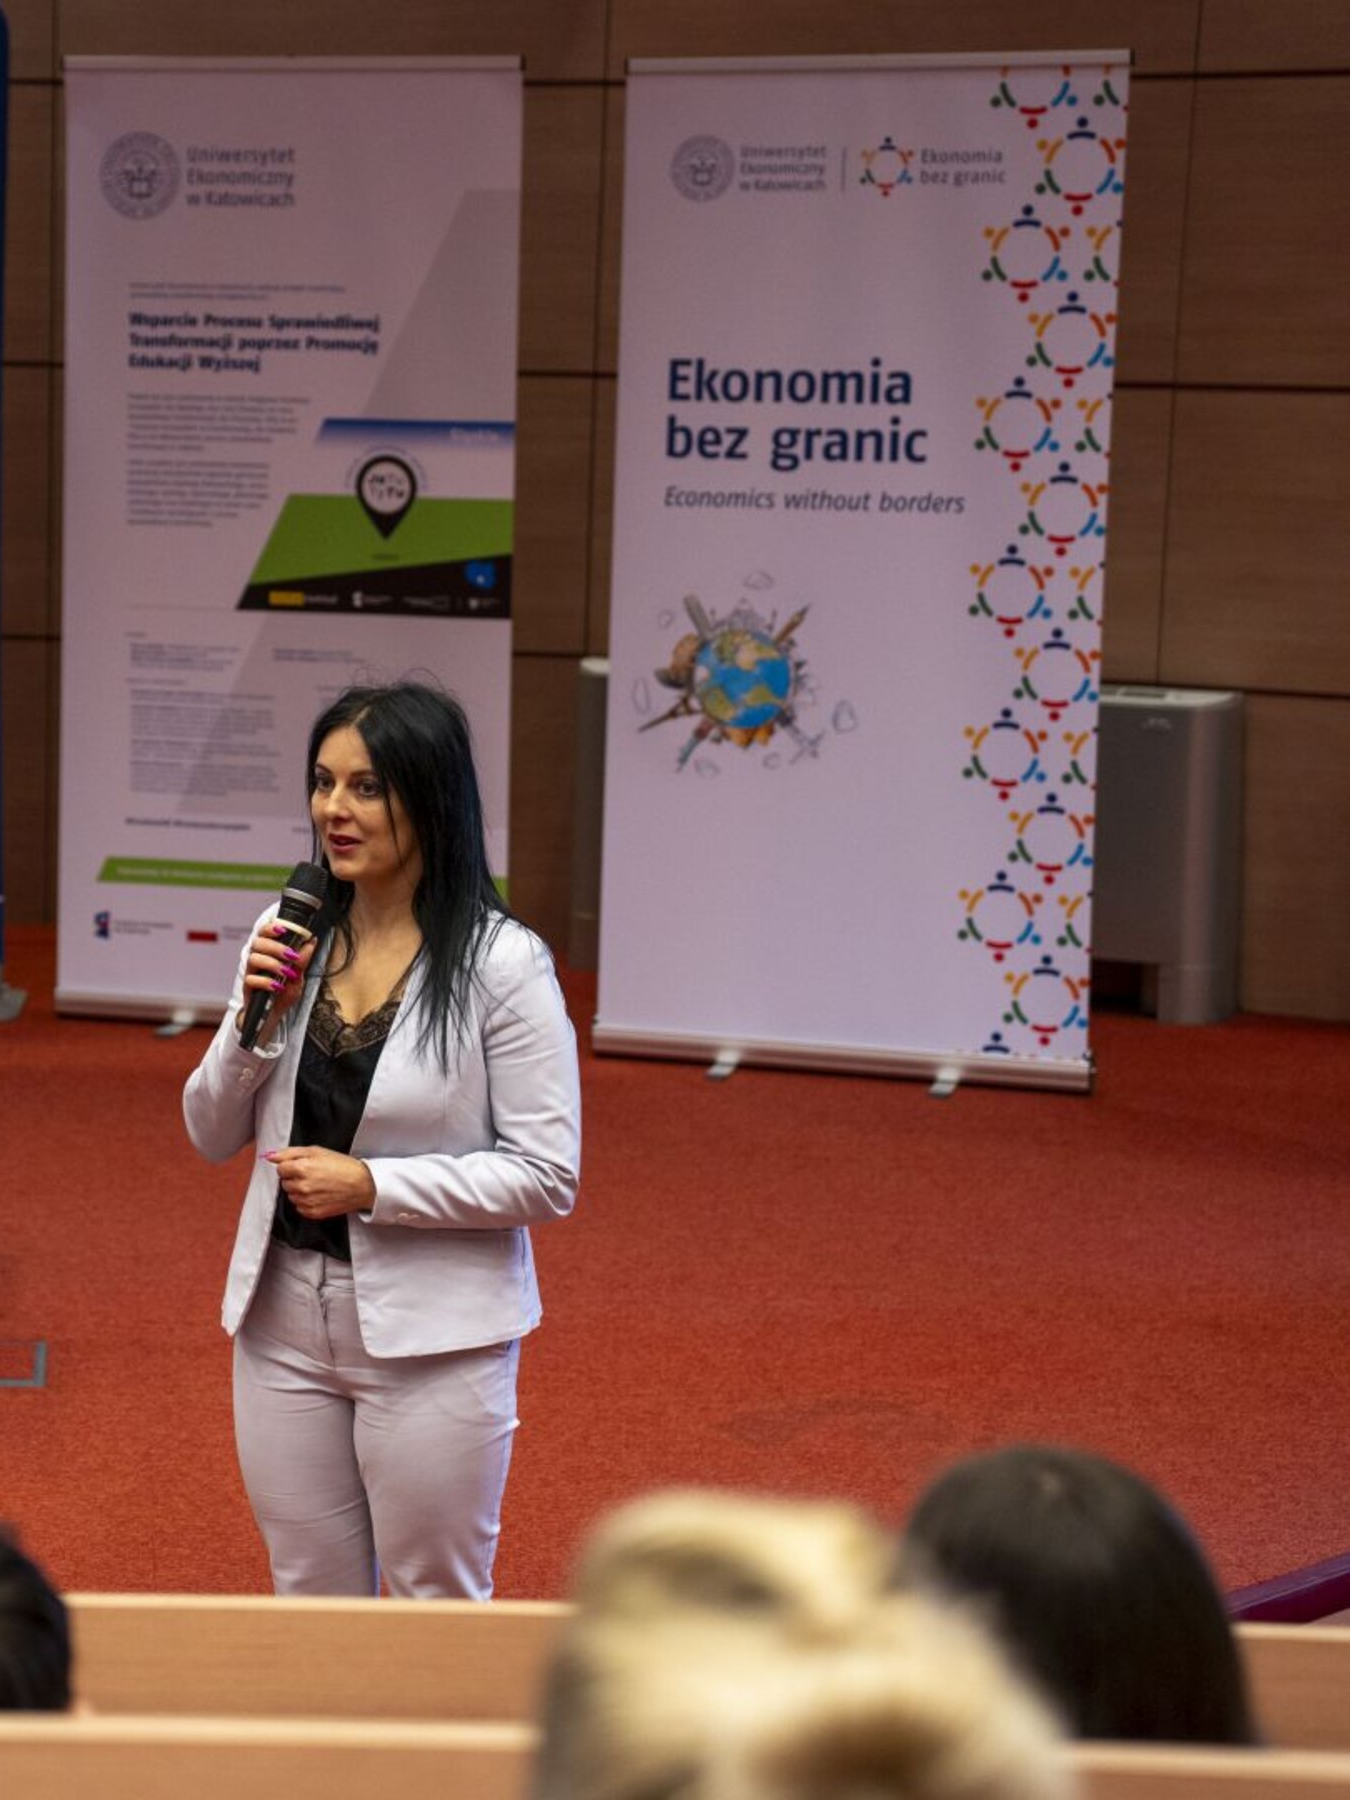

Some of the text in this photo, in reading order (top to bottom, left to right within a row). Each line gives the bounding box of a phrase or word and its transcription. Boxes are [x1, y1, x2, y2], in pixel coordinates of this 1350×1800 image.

[186, 147, 295, 166] Uniwersytet
[740, 145, 827, 161] Uniwersytet
[920, 148, 1003, 165] Ekonomia
[186, 167, 295, 189] Ekonomiczny
[739, 161, 826, 177] Ekonomiczny
[919, 169, 1006, 188] bez granic
[752, 178, 827, 192] Katowicach
[186, 190, 295, 208] w Katowicach
[129, 312, 380, 334] Wsparcie Procesu Sprawiedliwej
[129, 333, 233, 352] Transformacji
[238, 337, 300, 353] poprzez
[128, 353, 262, 374] Edukacji Wyższej
[668, 357, 912, 405] Ekonomia
[666, 414, 929, 473] bez granic
[663, 485, 965, 514] Economics without borders
